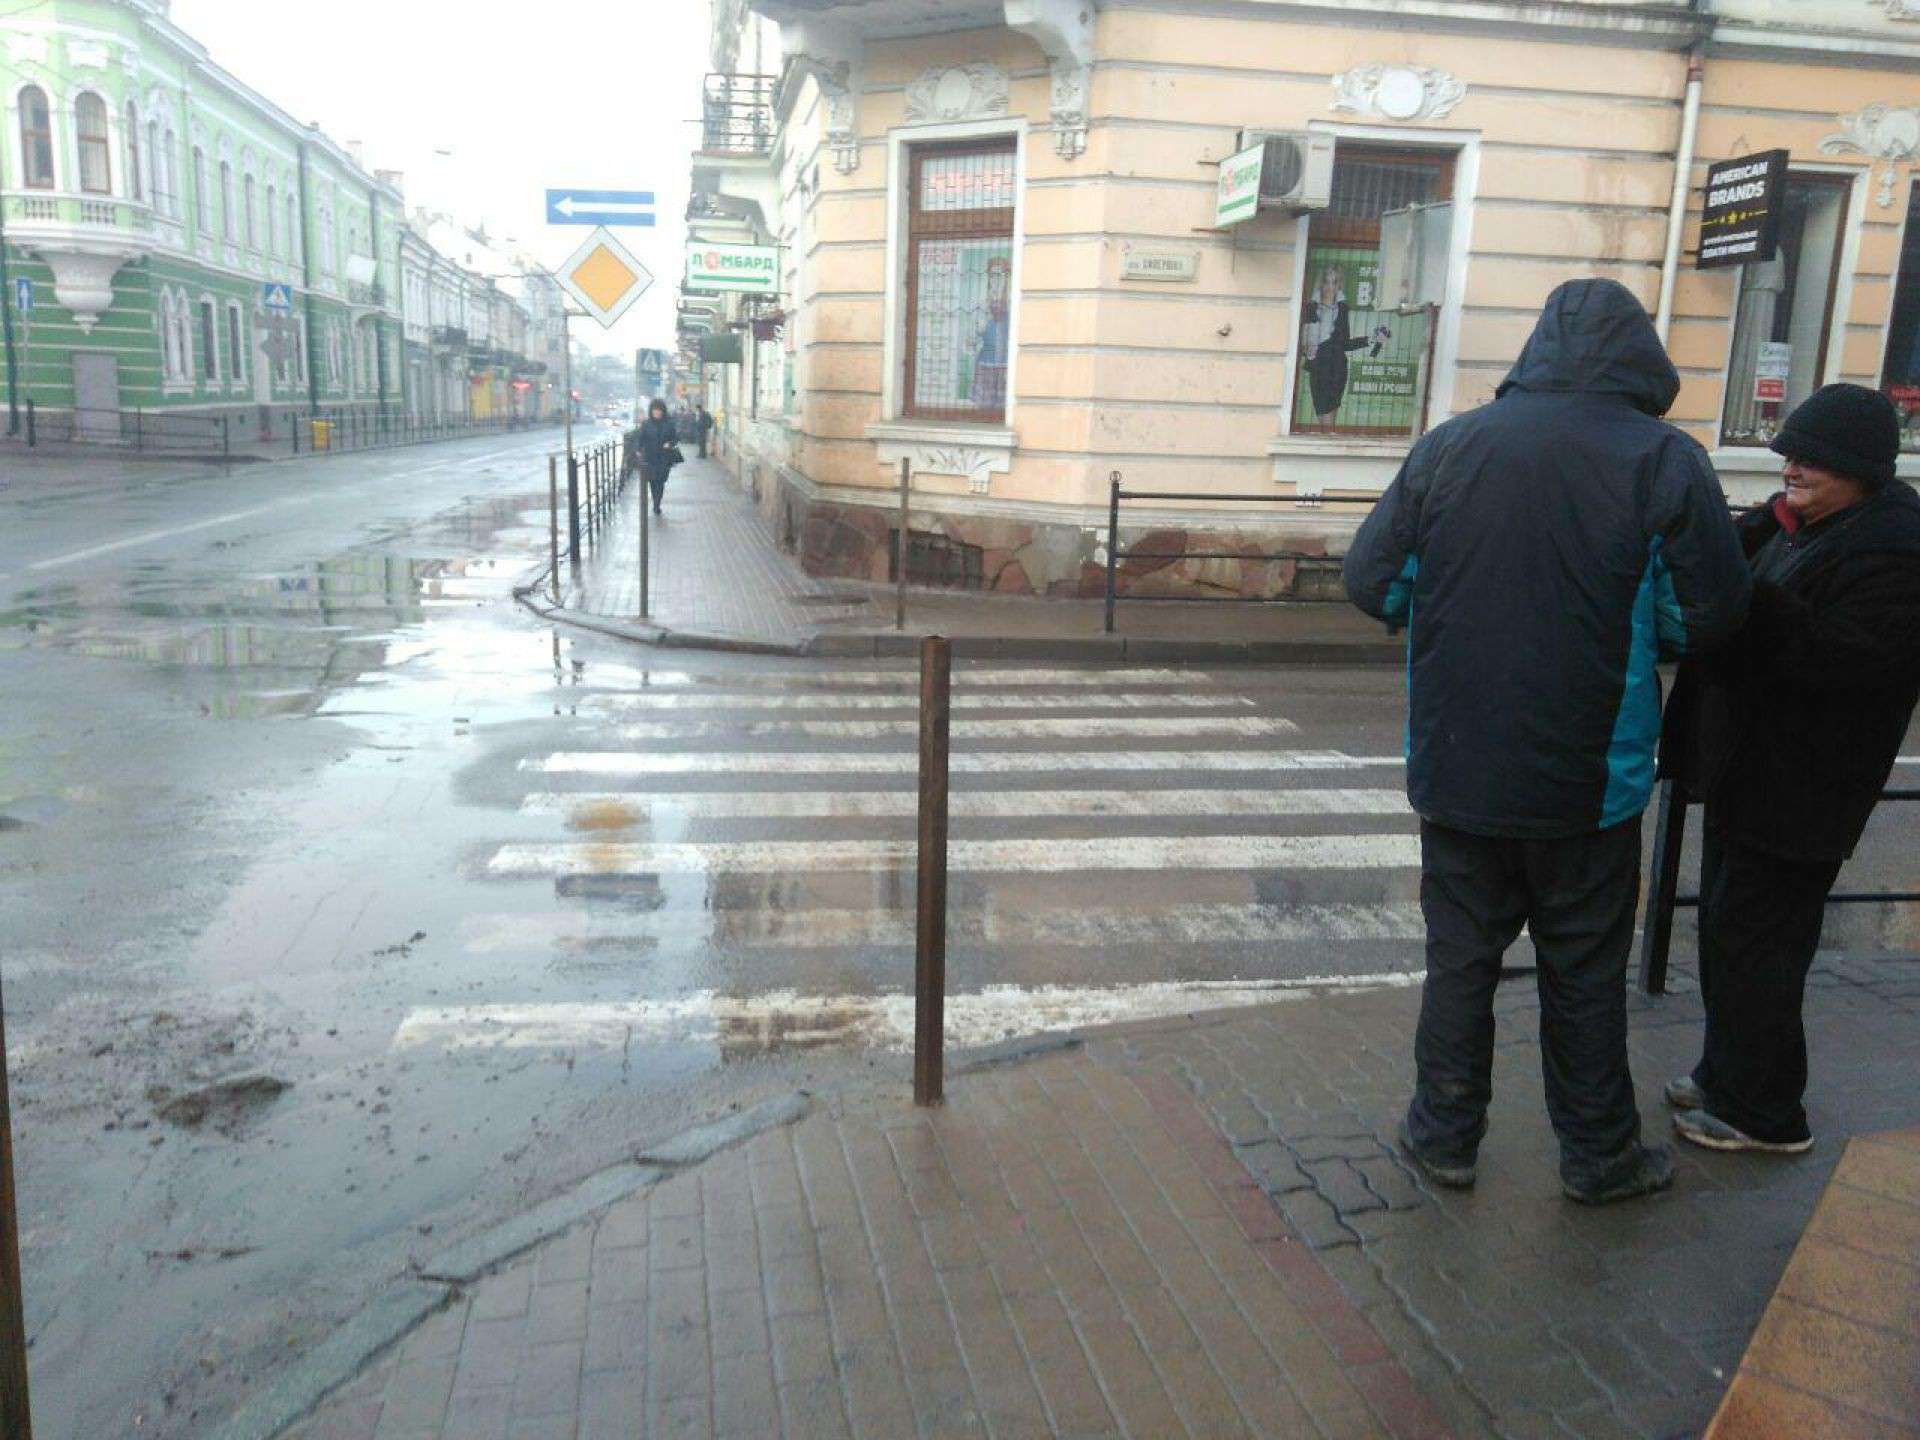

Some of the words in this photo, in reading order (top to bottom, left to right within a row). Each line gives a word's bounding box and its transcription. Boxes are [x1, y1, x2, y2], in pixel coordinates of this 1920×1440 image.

[1712, 161, 1768, 186] AMERICAN
[1708, 181, 1765, 207] BRANDS
[692, 251, 774, 271] ЛОМБАРД
